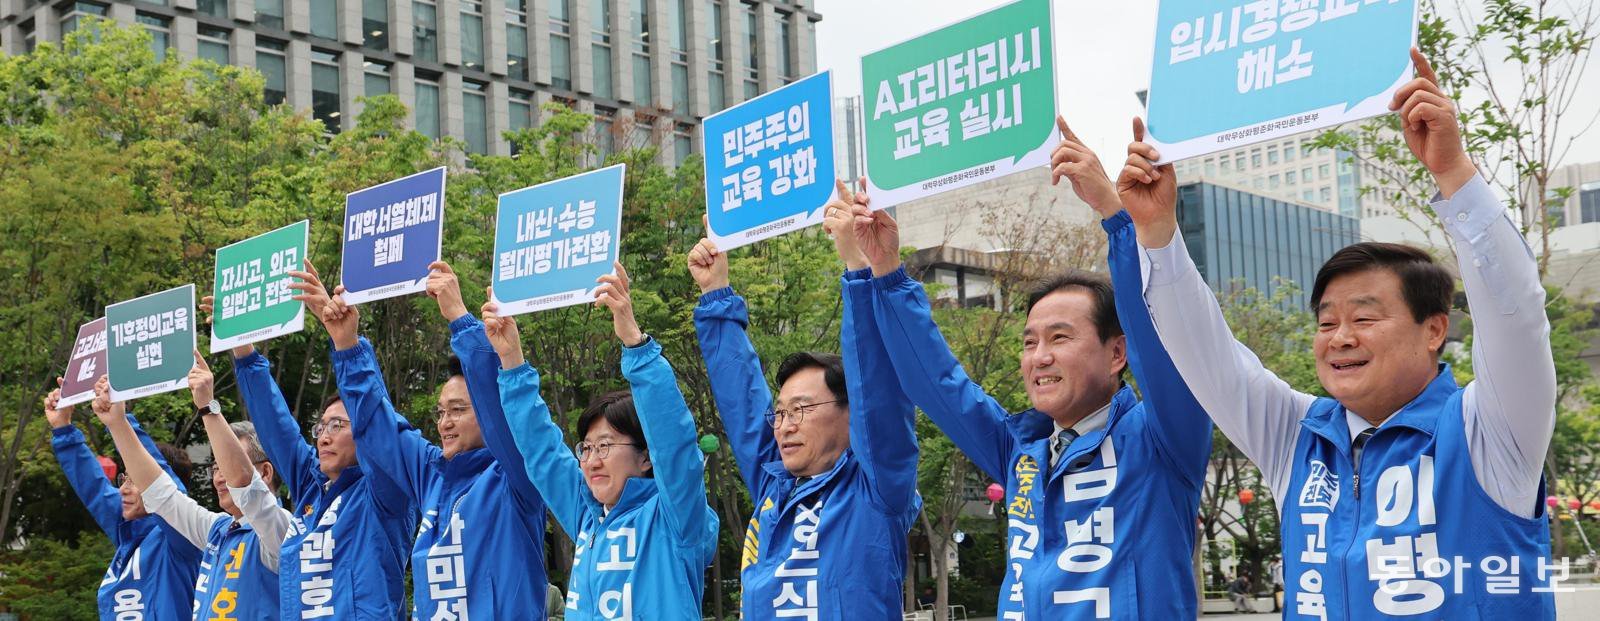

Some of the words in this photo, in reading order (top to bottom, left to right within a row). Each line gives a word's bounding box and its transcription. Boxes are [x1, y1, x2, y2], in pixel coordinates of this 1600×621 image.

[1169, 0, 1401, 65] 입시경쟁
[1237, 38, 1314, 94] 해소
[723, 101, 810, 169] 민주주의
[893, 107, 950, 161] 교육
[960, 83, 1023, 142] 실시
[721, 165, 763, 212] 교육
[769, 145, 817, 196] 강화
[269, 246, 297, 278] 외고
[374, 234, 404, 267] 철폐
[111, 307, 188, 347] 기후정의교육
[221, 286, 262, 320] 일반고
[136, 341, 163, 370] 실현
